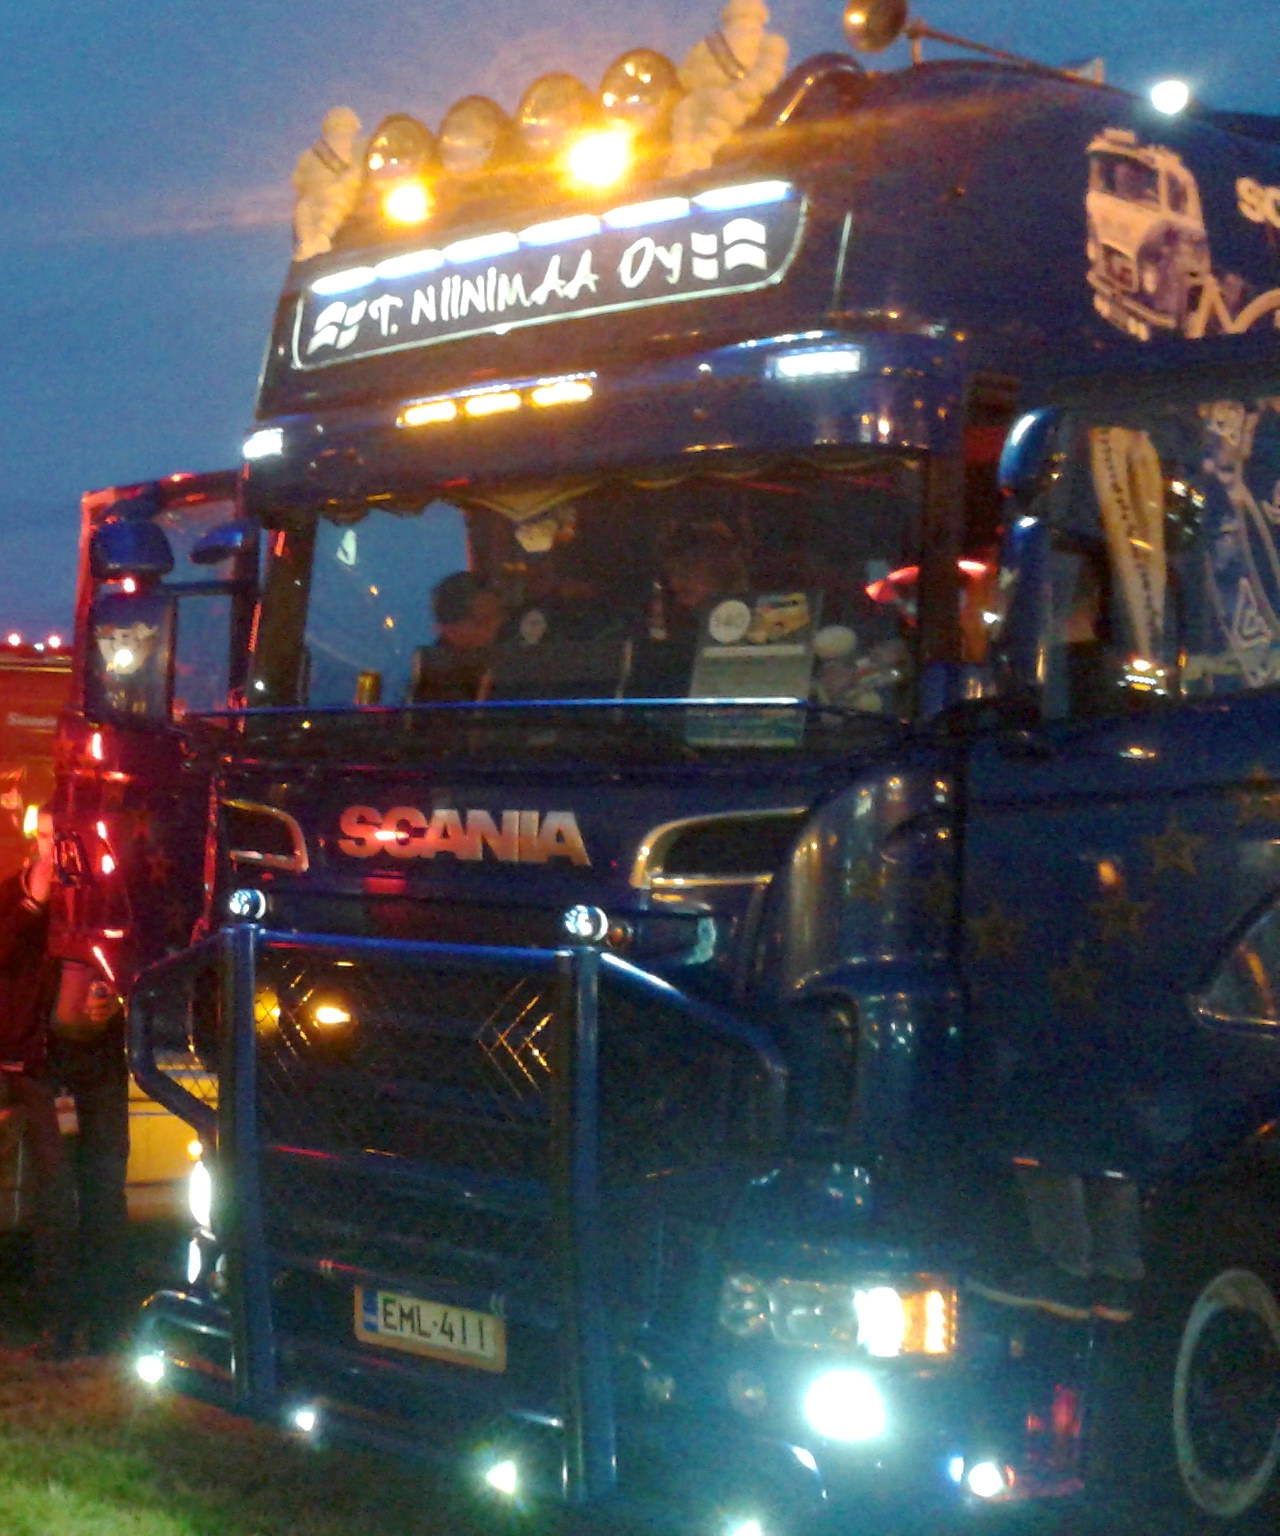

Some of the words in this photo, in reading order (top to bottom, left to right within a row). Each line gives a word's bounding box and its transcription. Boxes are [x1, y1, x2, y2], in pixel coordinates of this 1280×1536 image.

[369, 294, 404, 337] T.
[339, 806, 592, 867] SCANIA
[381, 1296, 488, 1351] EML-411
